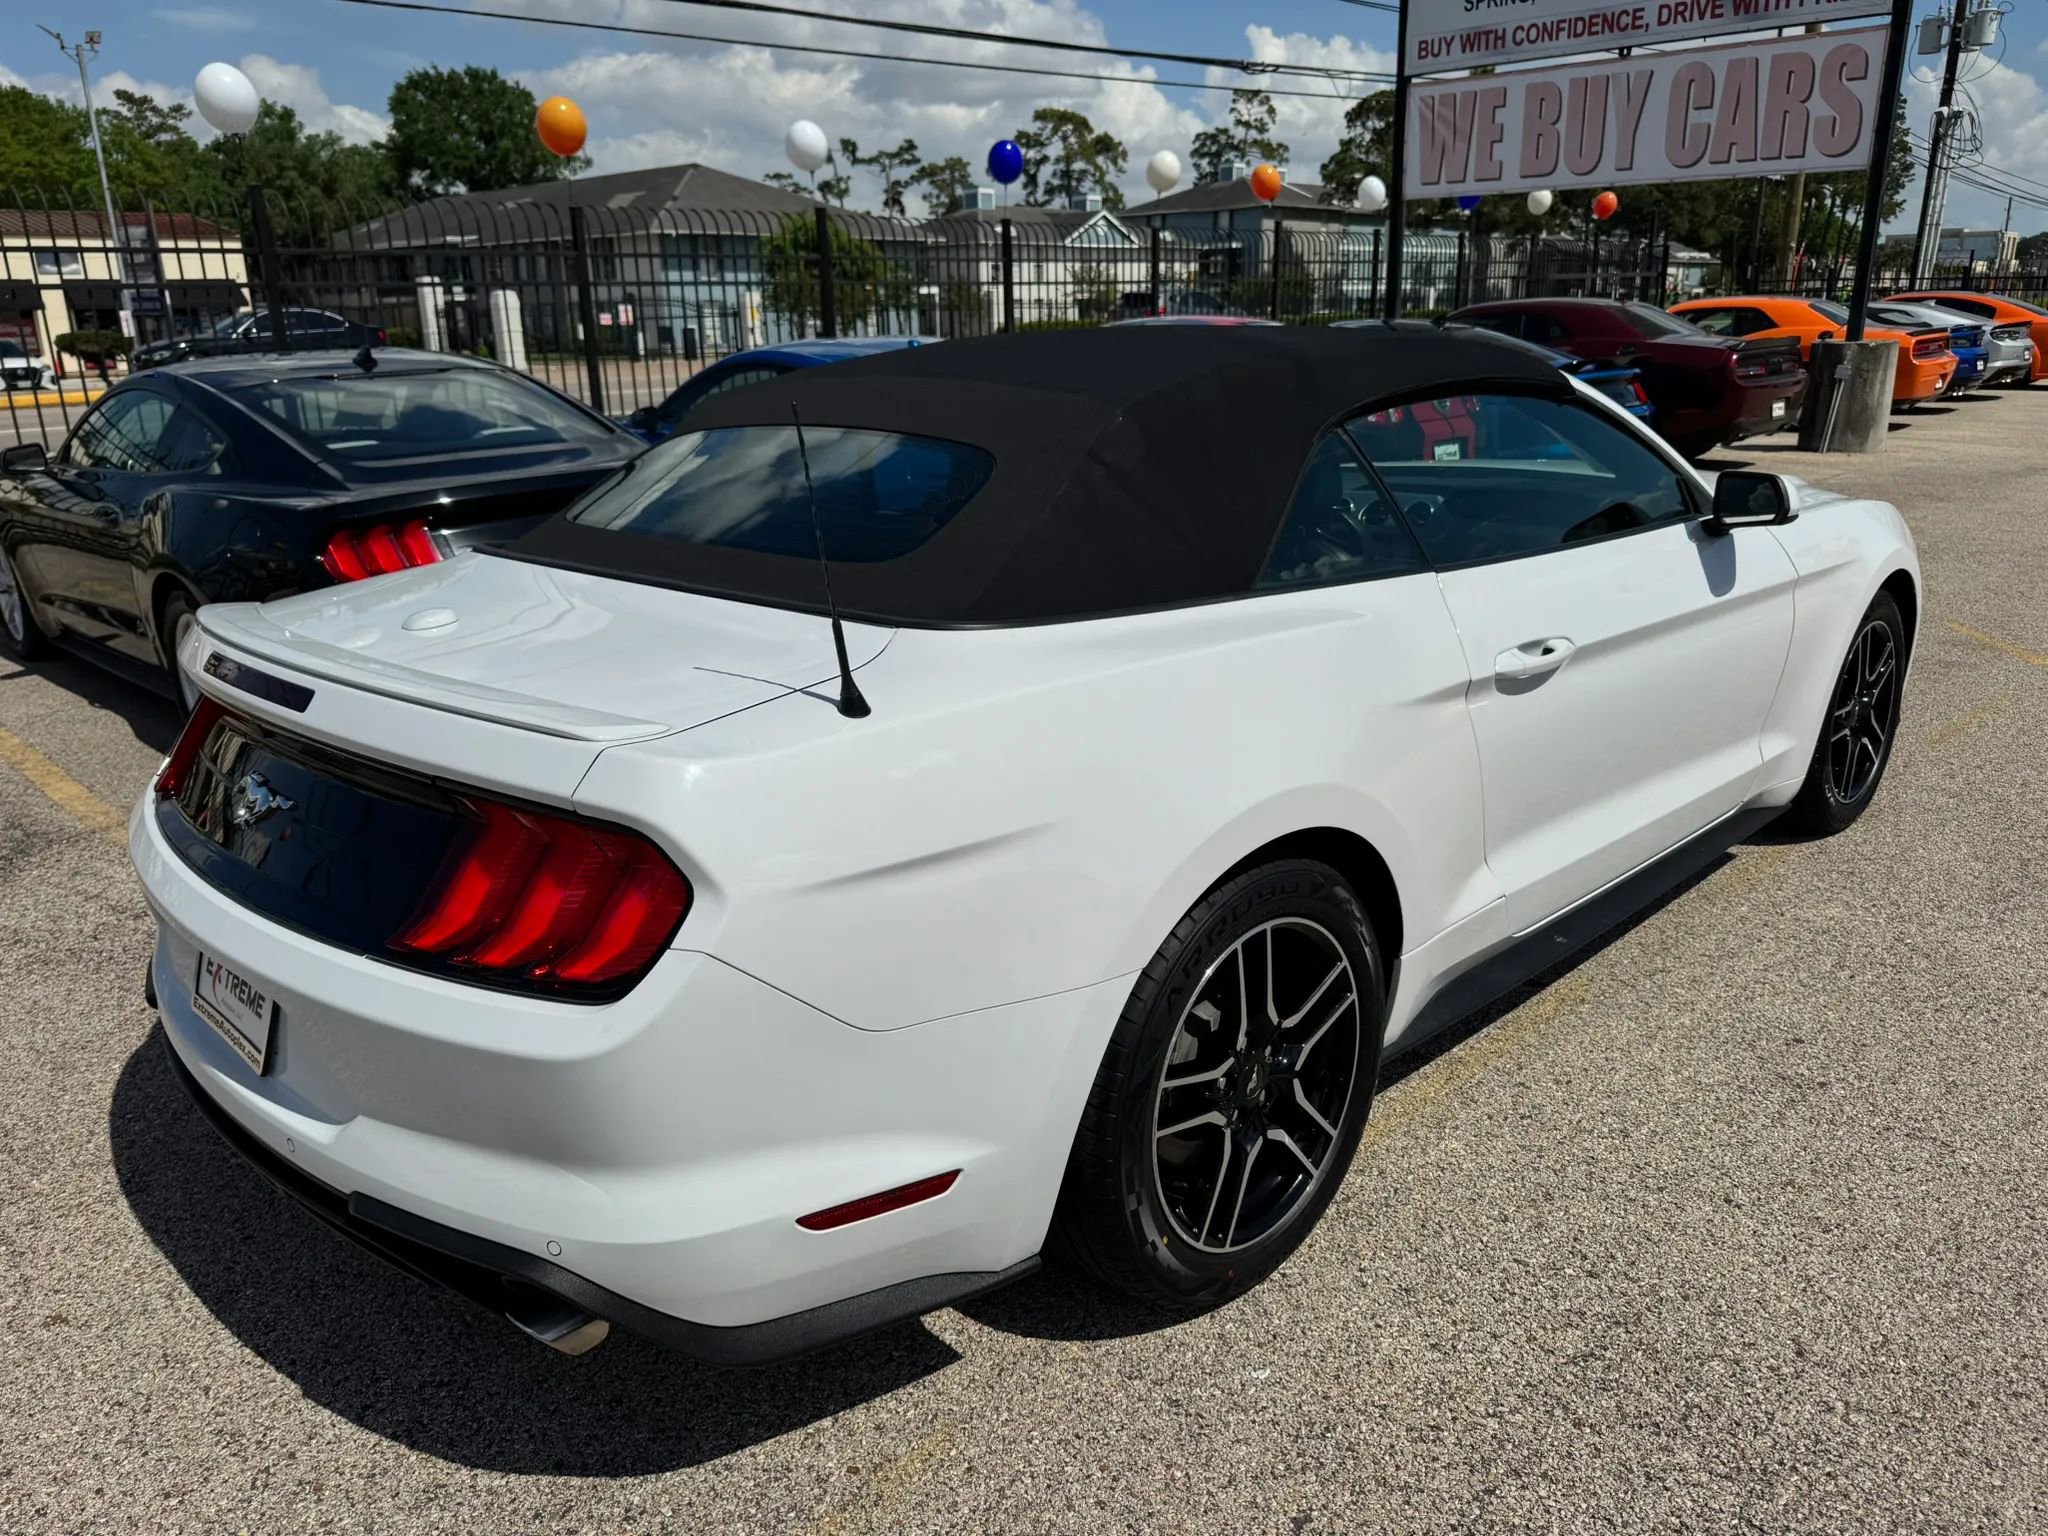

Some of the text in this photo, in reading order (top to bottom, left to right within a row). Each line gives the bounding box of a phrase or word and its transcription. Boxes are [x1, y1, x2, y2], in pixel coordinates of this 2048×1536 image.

[1417, 35, 1456, 60] BUY
[1459, 28, 1506, 54] WITH
[1511, 7, 1650, 46] CONFIDENCE,
[1656, 0, 1724, 26] DRIVE
[1464, 0, 1535, 12] SPR,
[1418, 42, 1870, 186] WE BUY CARS
[205, 956, 267, 1021] EXTREME
